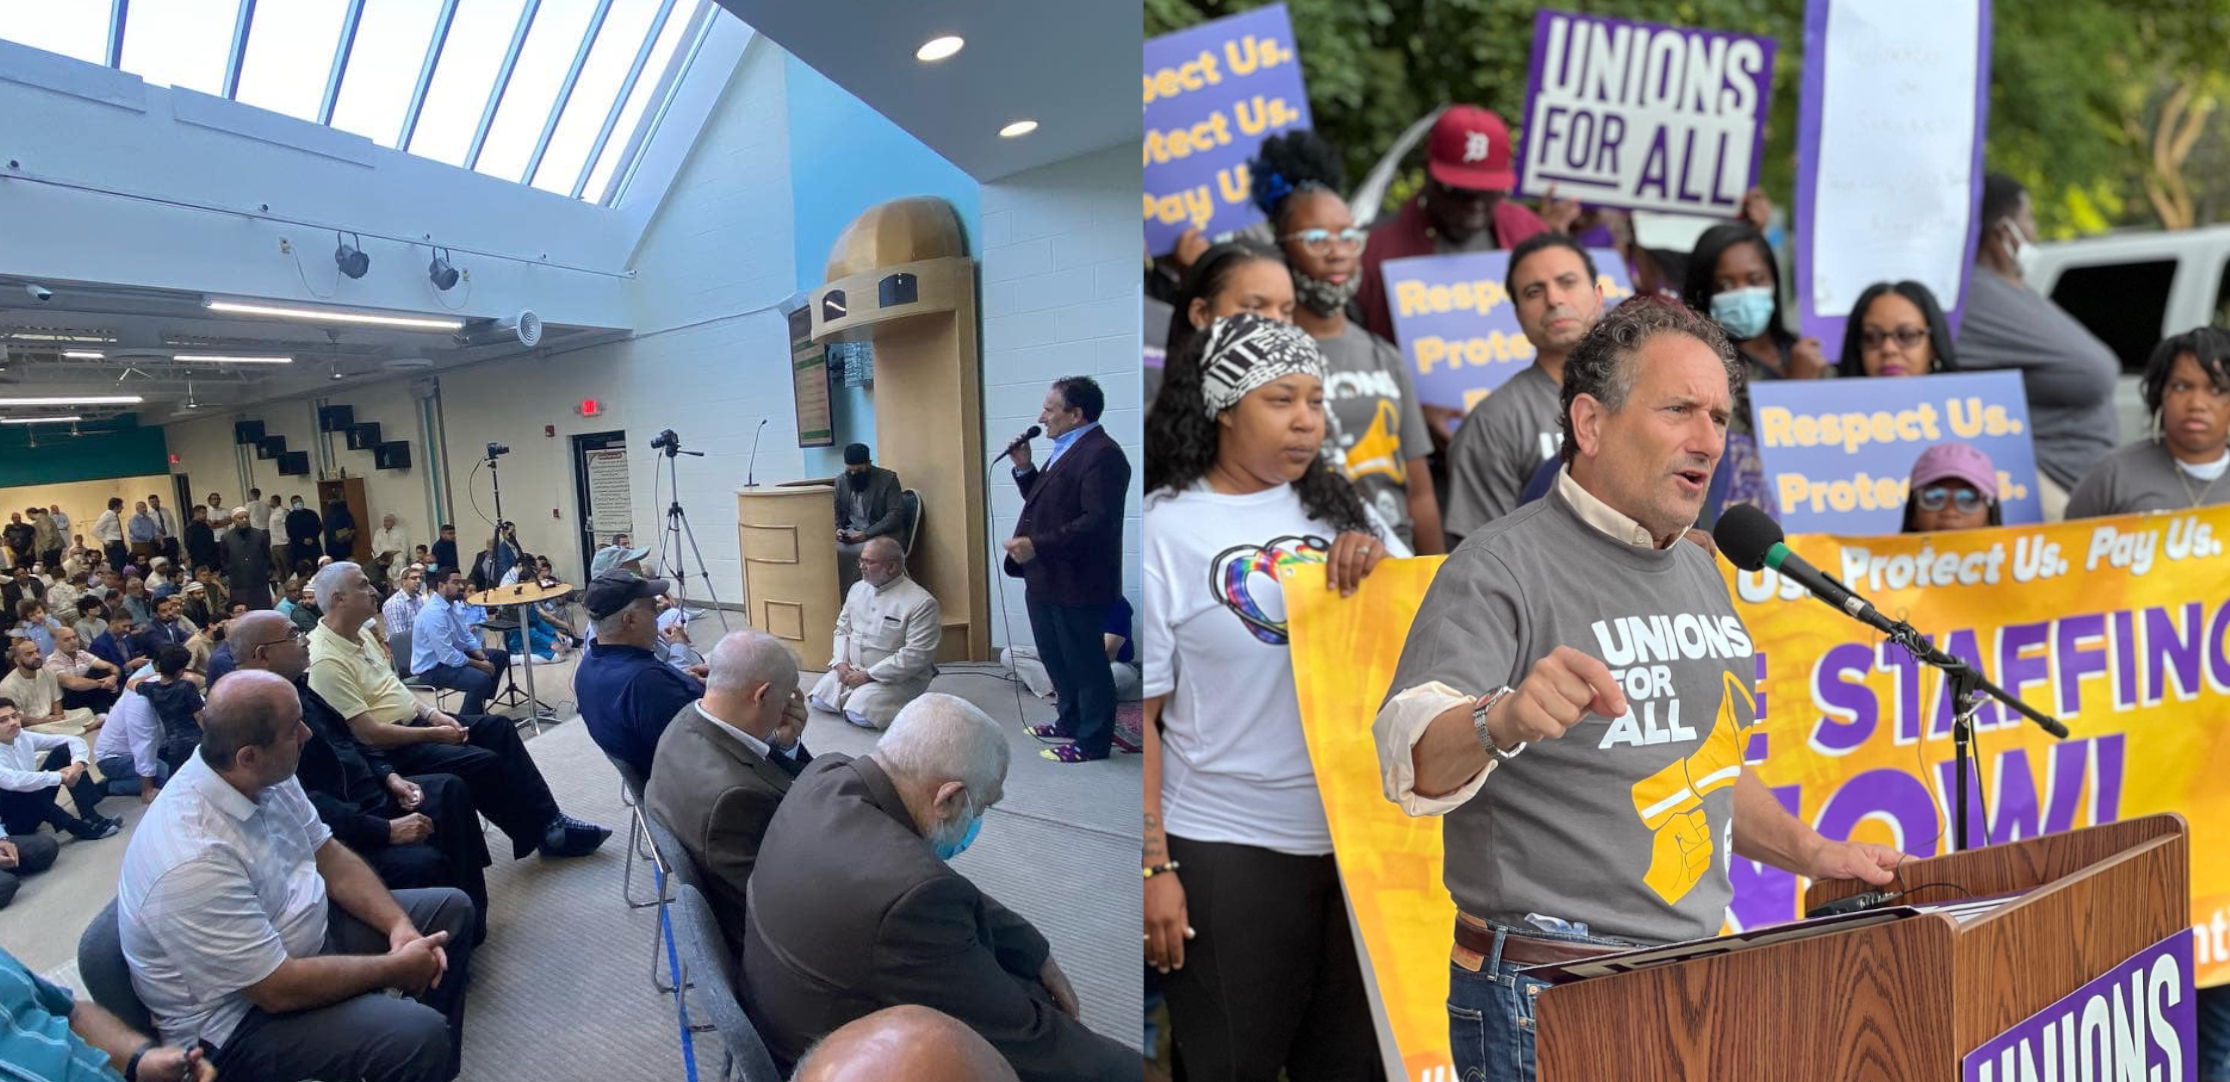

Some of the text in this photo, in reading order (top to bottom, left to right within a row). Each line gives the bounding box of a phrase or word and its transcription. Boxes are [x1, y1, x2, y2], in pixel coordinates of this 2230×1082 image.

[1224, 35, 1293, 76] Us.
[1542, 16, 1763, 116] UNIONS
[1143, 95, 1300, 168] tect Us.
[1539, 106, 1736, 205] FOR ALL
[1759, 397, 2024, 454] Respect Us.
[1841, 543, 2005, 592] Protect
[2012, 534, 2069, 582] Us.
[2085, 525, 2159, 576] Pay
[2164, 515, 2223, 561] Us.
[1591, 612, 1753, 667] UNIONS
[1598, 699, 1698, 750] ALL
